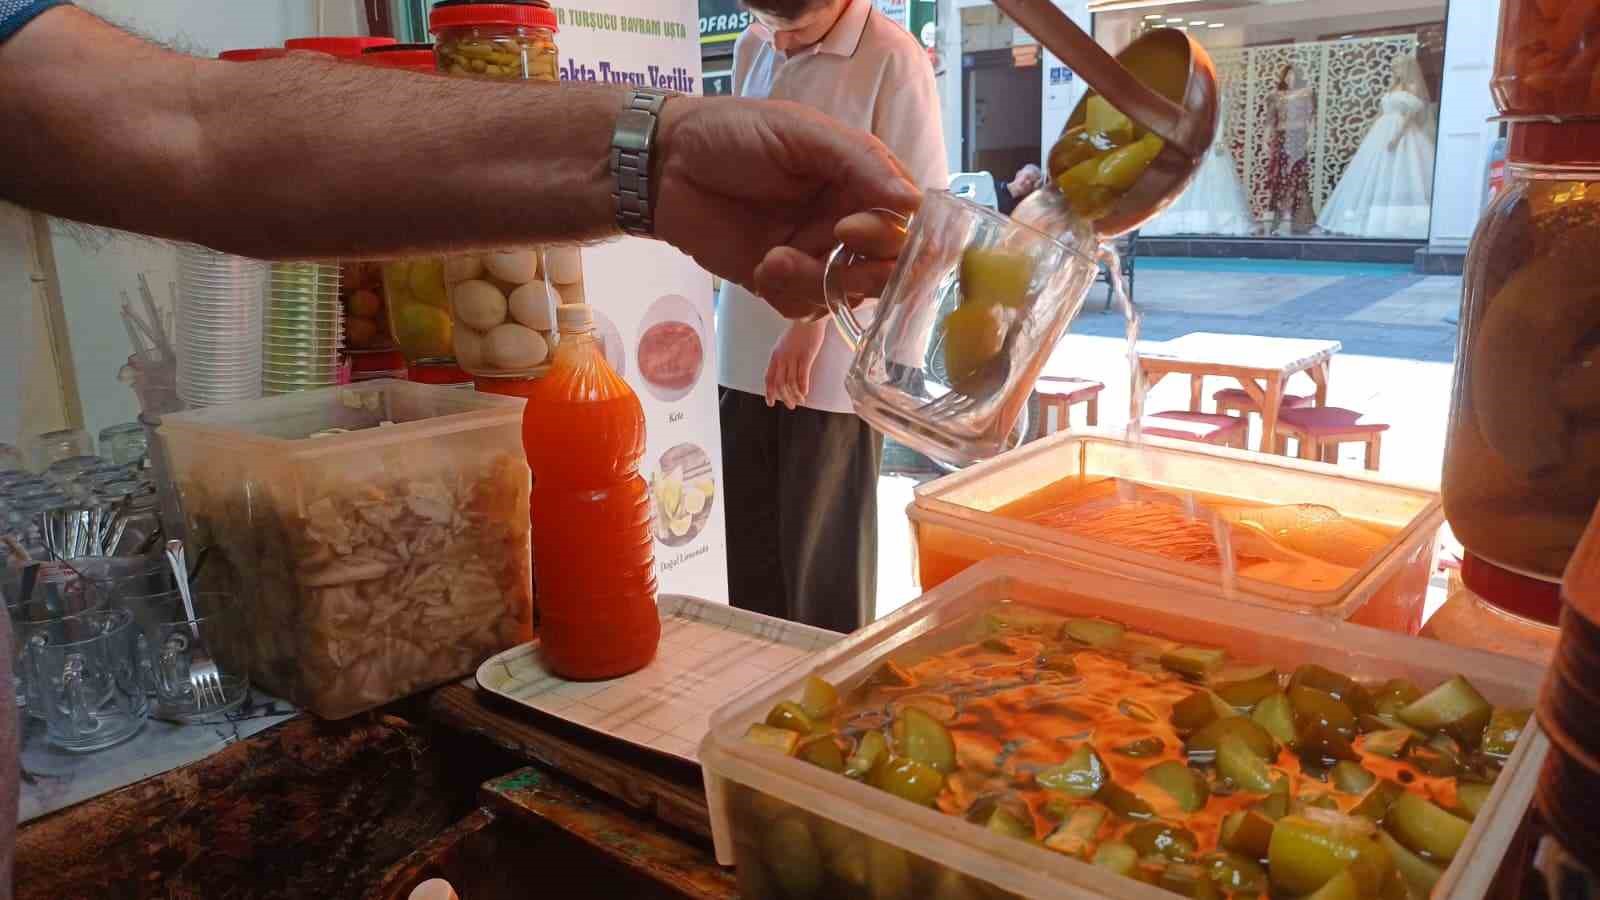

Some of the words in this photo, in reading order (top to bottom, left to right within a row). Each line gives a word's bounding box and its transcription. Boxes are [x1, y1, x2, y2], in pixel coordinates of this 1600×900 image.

[568, 9, 618, 32] TURŞUCU
[620, 15, 662, 37] BAYRAM
[648, 64, 695, 93] Verilir
